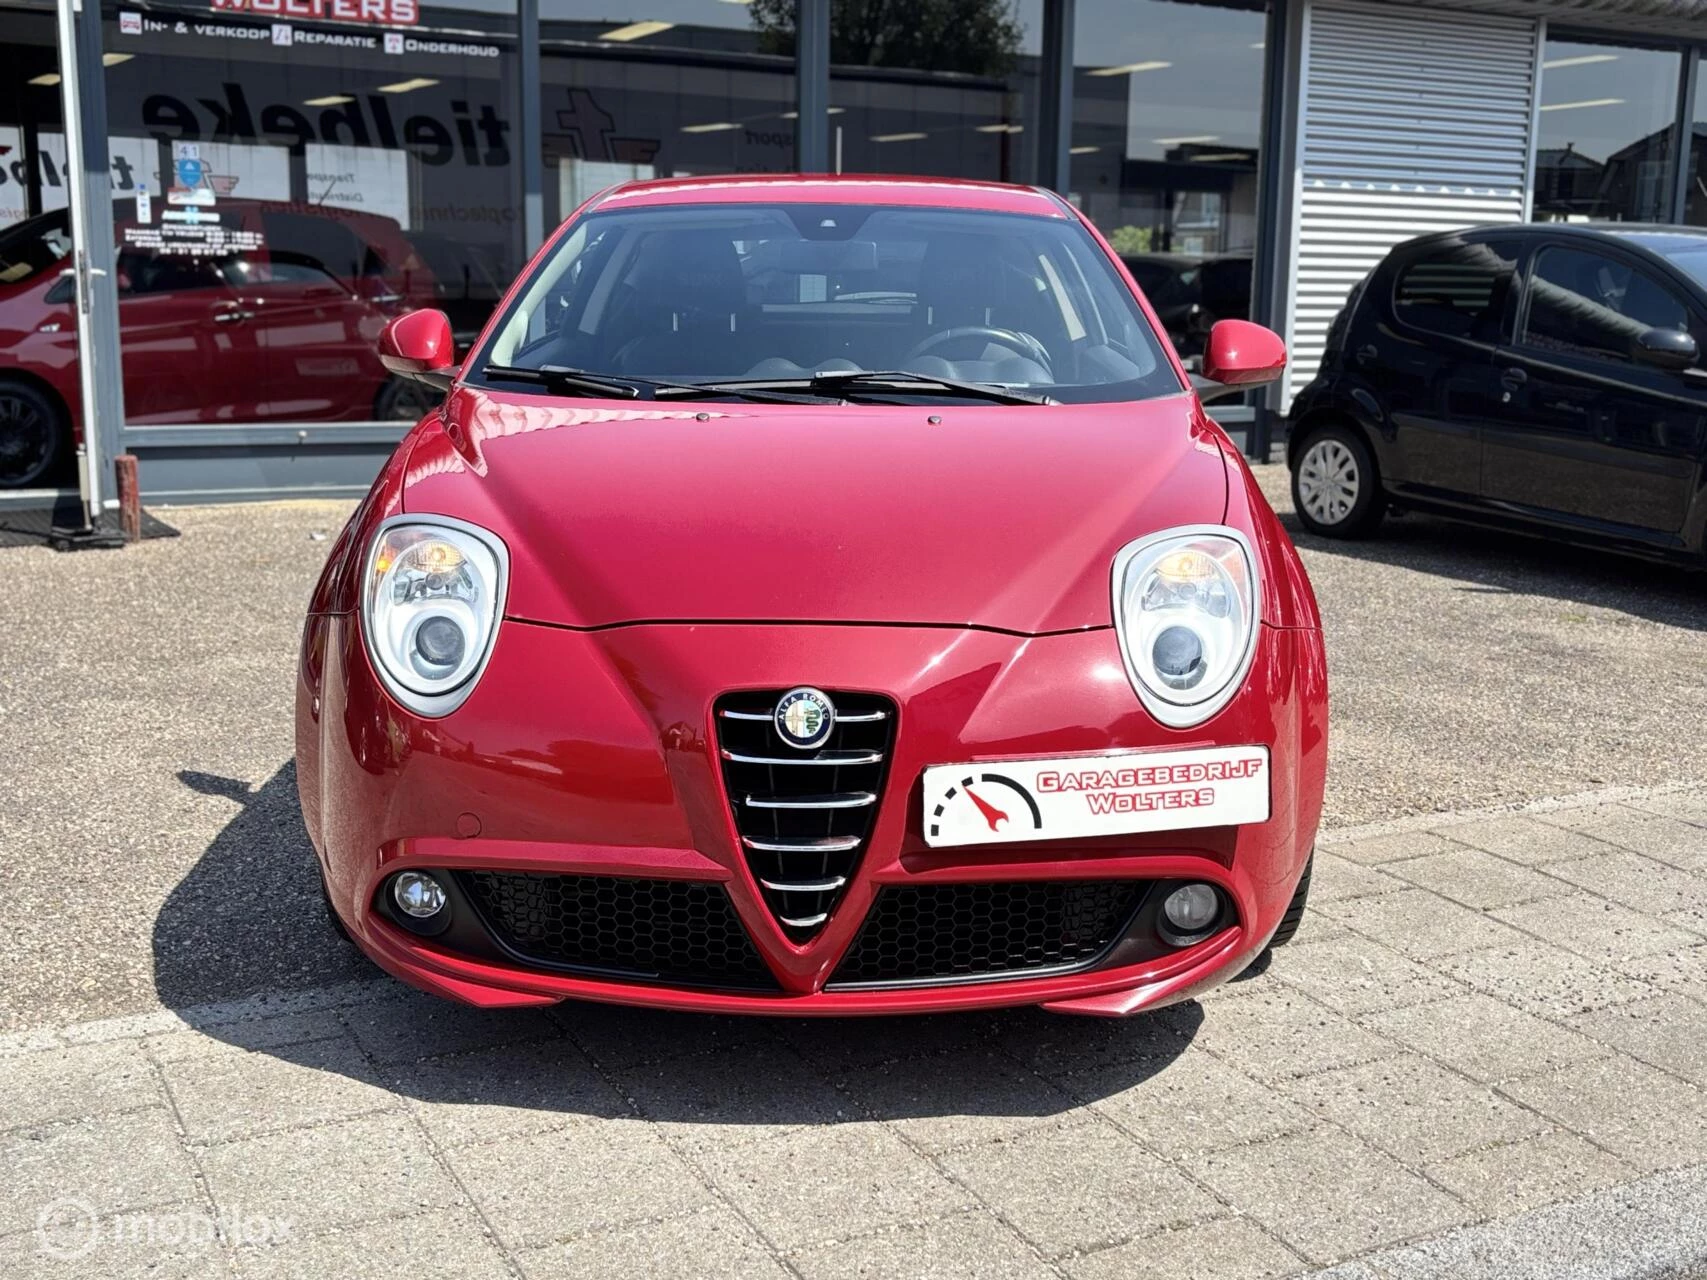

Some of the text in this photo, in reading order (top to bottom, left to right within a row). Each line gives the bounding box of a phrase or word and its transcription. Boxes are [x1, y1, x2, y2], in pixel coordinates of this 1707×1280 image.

[174, 22, 188, 35] &
[194, 24, 271, 41] VERKOOP
[294, 30, 376, 49] REPARATIE
[404, 38, 500, 58] ONDERHOUD
[778, 693, 830, 721] ALFA ROMEO
[1036, 759, 1262, 792] GARAGEBEDRIJF
[1086, 788, 1214, 815] WOLTERS
